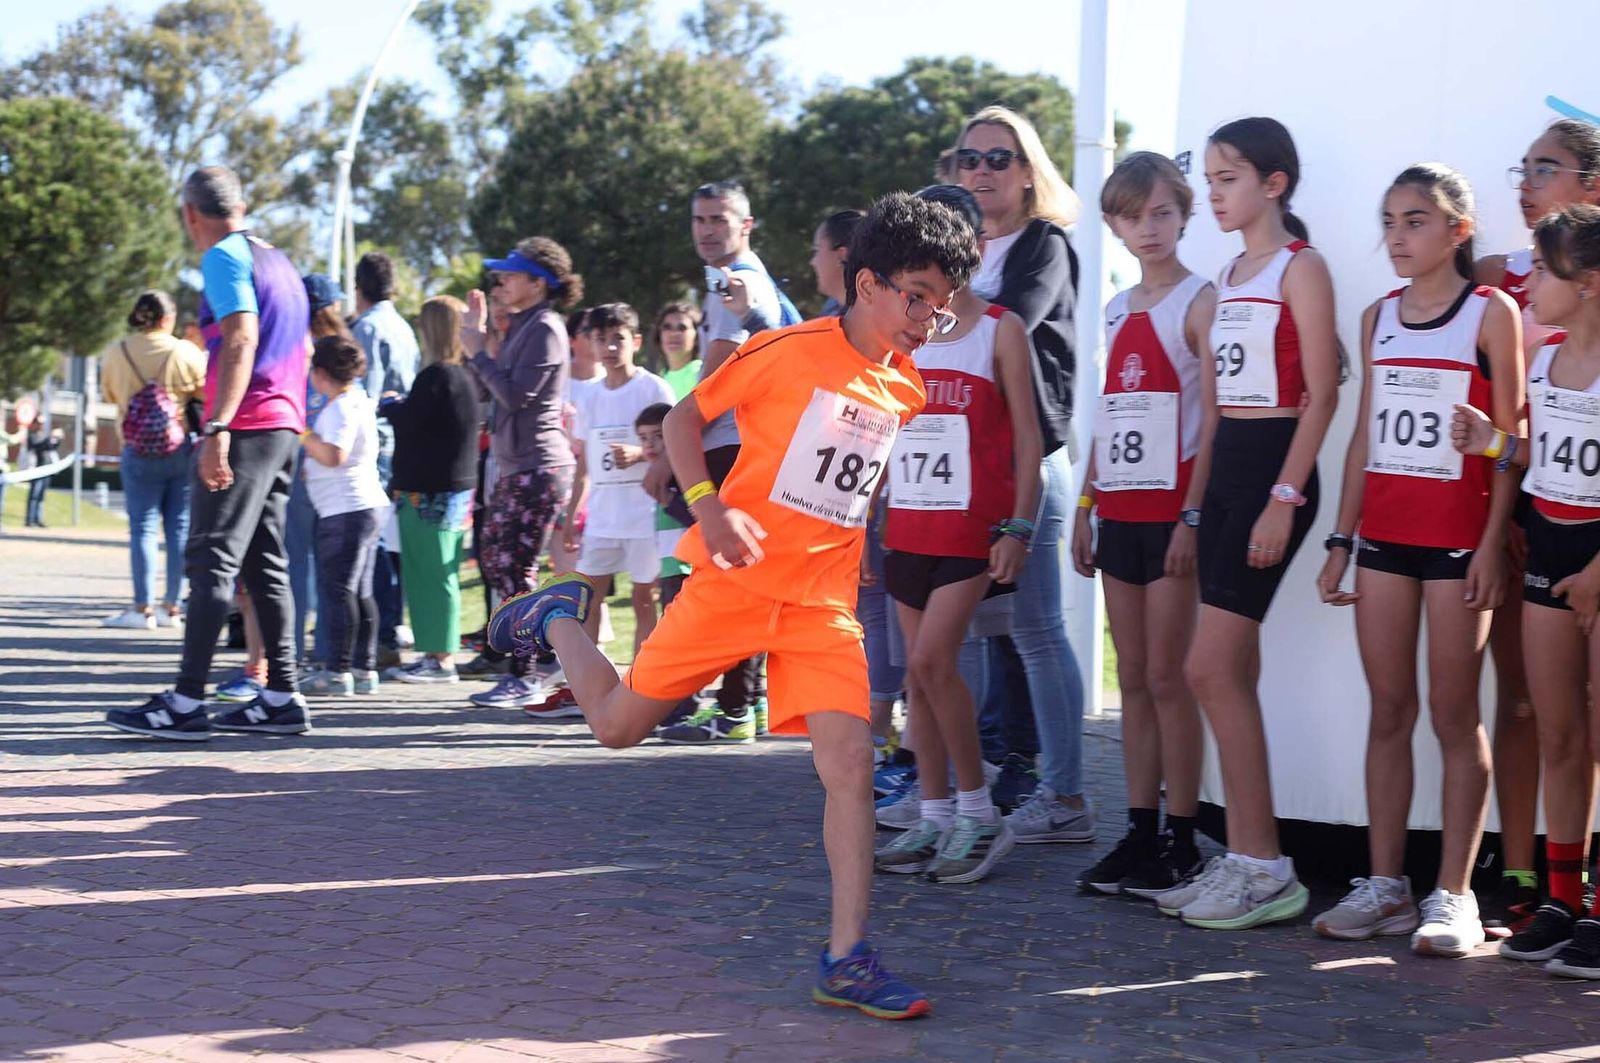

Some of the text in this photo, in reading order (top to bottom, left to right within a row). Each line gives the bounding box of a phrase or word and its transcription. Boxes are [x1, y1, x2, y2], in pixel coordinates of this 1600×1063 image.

[1215, 342, 1244, 377] 69
[1377, 408, 1442, 448] 103
[1110, 430, 1144, 464] 68
[1538, 431, 1600, 477] 140
[815, 445, 882, 497] 182
[901, 452, 954, 485] 174
[781, 490, 813, 510] Huelva
